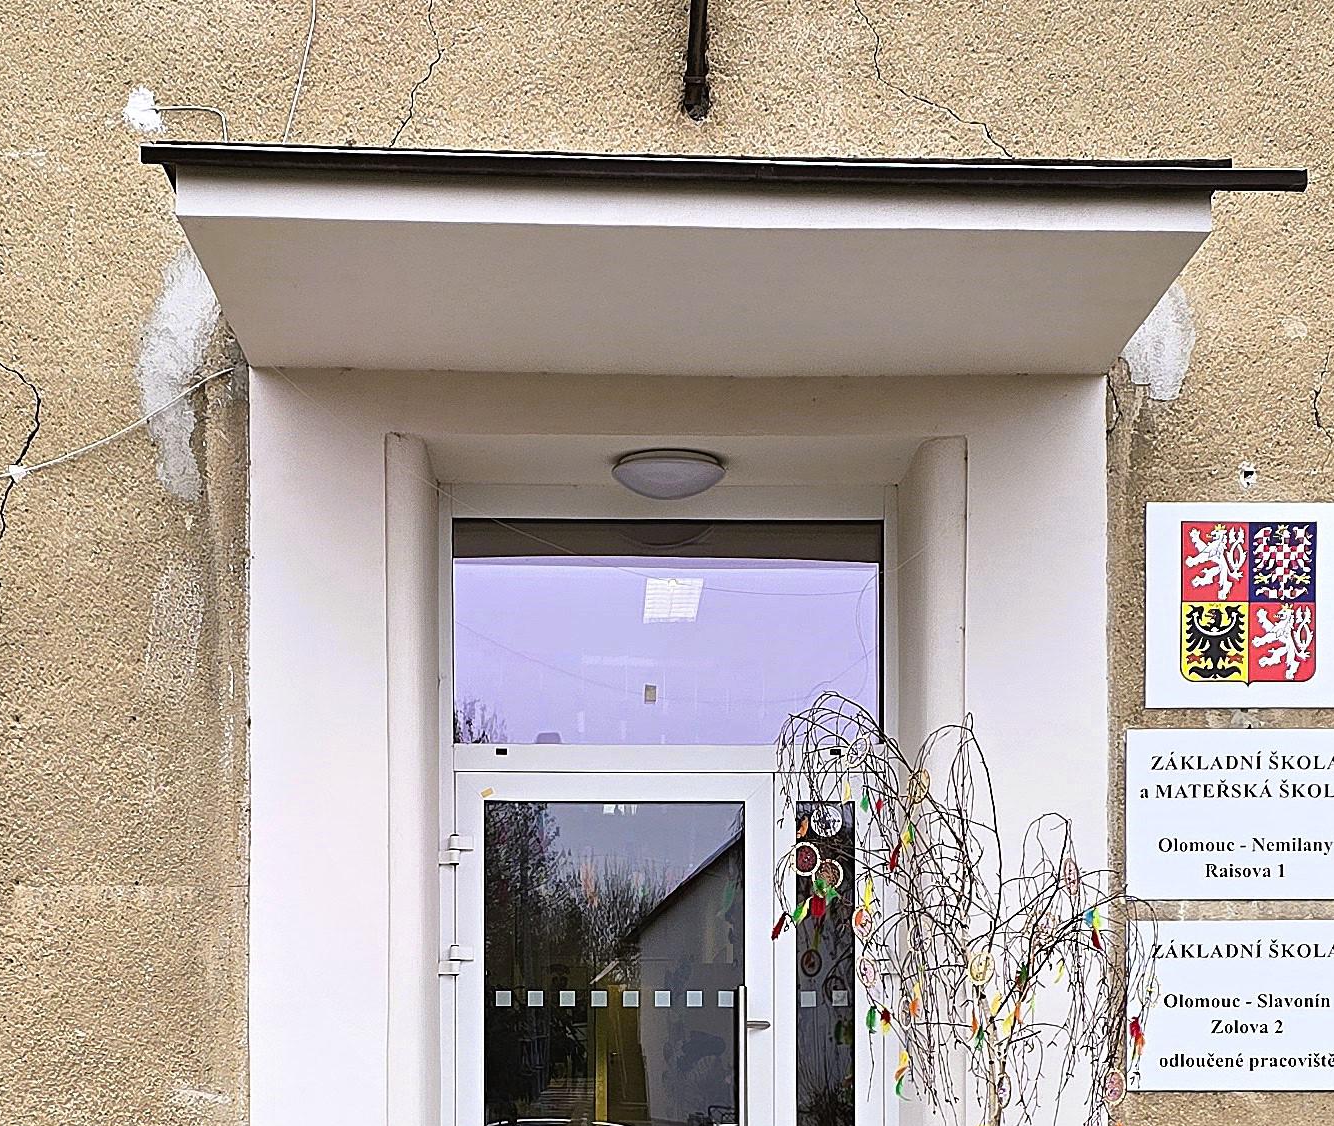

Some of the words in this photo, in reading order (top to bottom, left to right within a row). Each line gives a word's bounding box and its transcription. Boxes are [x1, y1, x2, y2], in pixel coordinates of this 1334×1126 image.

[1151, 751, 1262, 771] ZÁKLADNÍ
[1139, 788, 1149, 799] a
[1155, 779, 1273, 799] MATEŘSKÁ
[1158, 837, 1235, 853] Olomouc
[1252, 837, 1333, 856] Nemilany
[1205, 863, 1271, 878] Raisova
[1277, 863, 1284, 878] 1
[1151, 939, 1262, 959] ZÁKLADNÍ
[1163, 993, 1241, 1009] Olomouc
[1257, 993, 1331, 1009] Slavonín
[1210, 1019, 1269, 1035] Zolova
[1274, 1019, 1284, 1034] 2
[1159, 1052, 1244, 1068] odloučené
